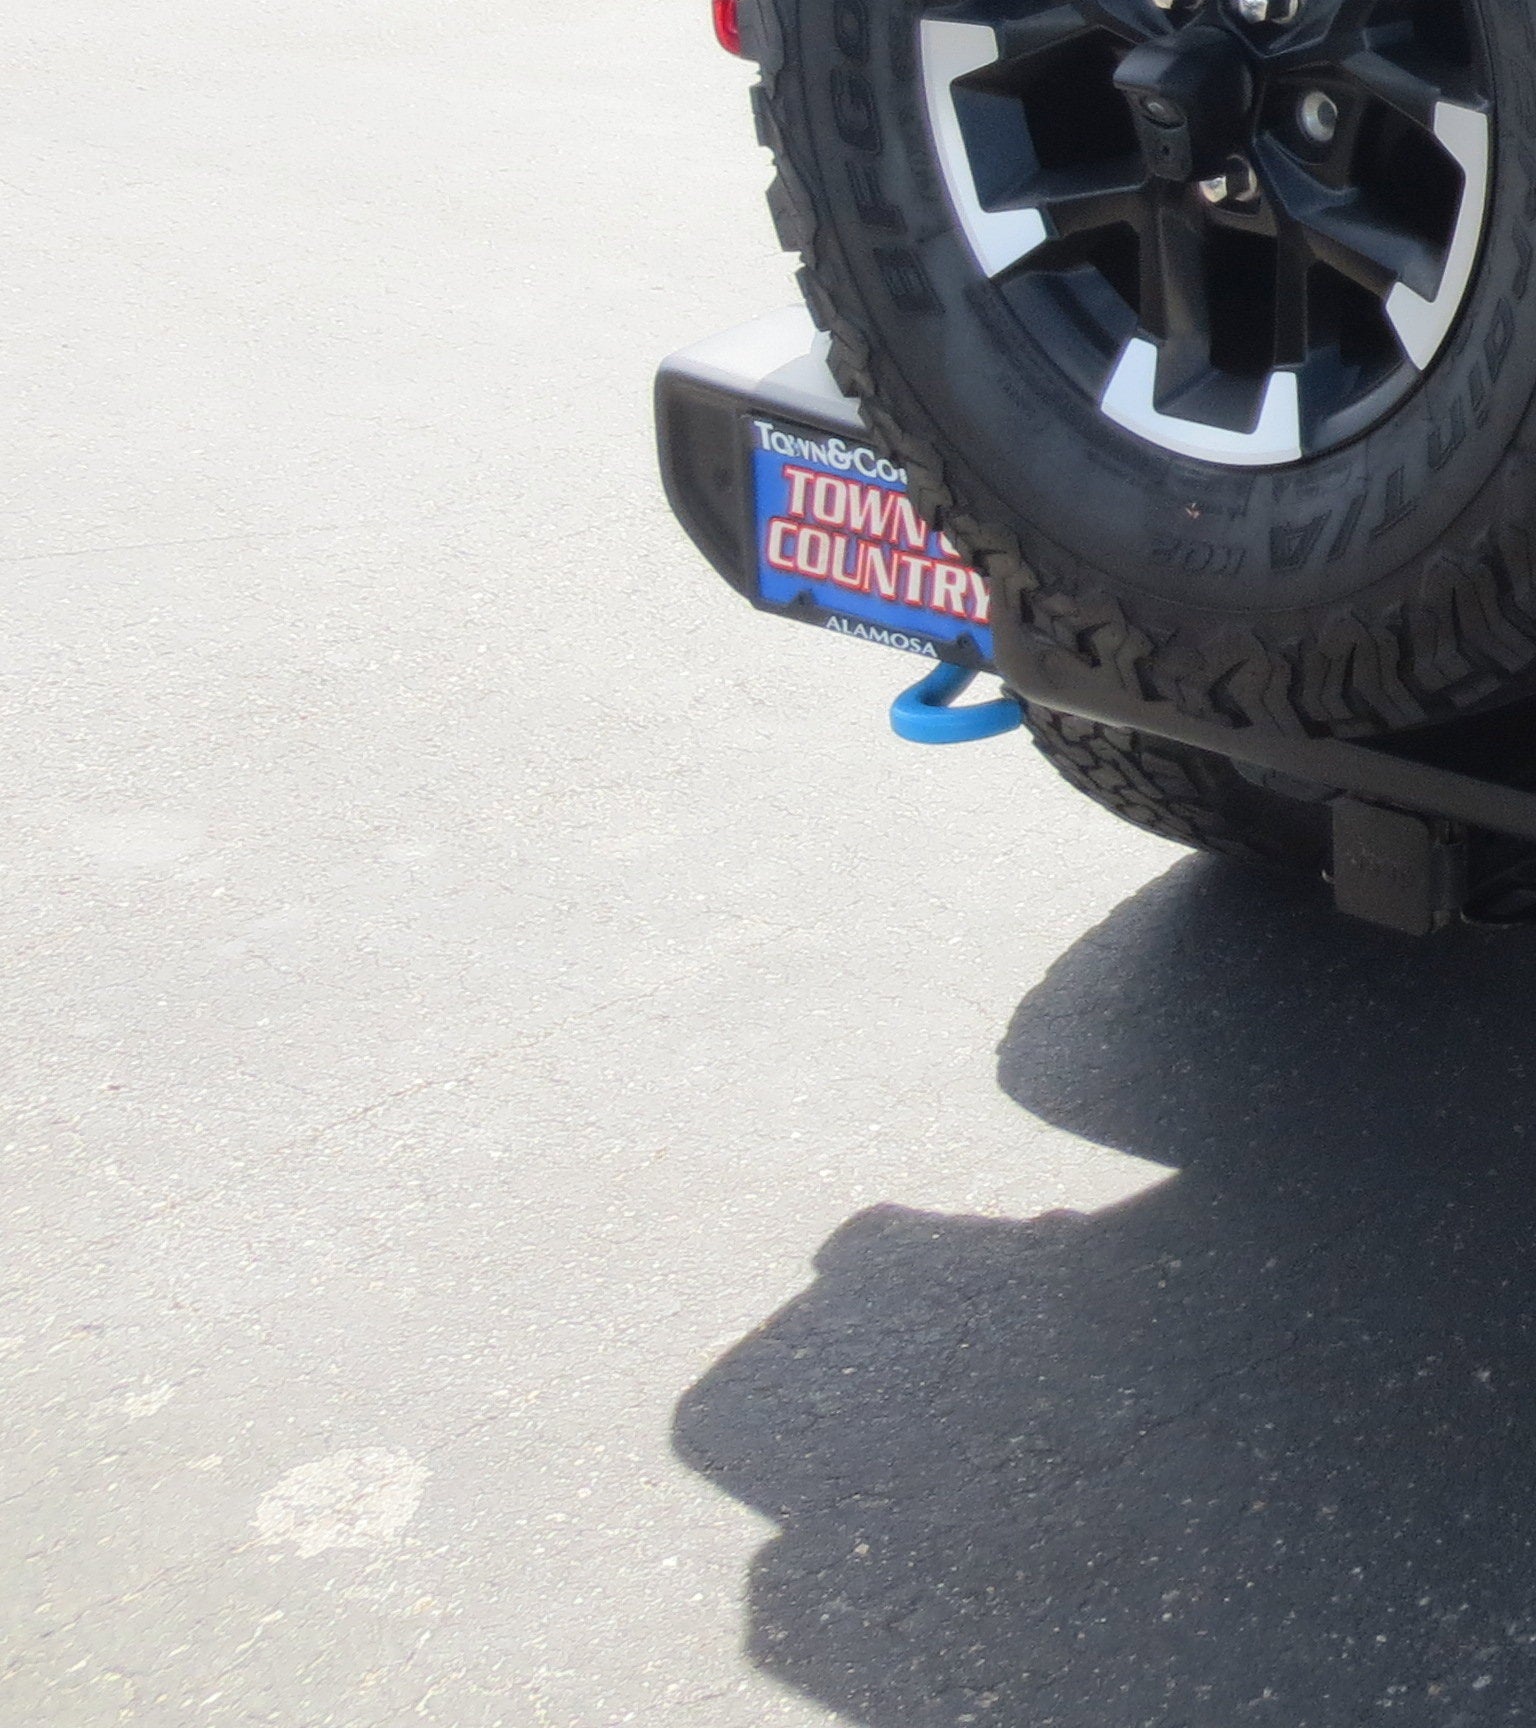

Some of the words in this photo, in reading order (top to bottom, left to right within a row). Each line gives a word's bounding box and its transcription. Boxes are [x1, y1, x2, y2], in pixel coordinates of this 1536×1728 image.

[783, 465, 927, 553] TOWN
[766, 517, 992, 624] COUNTRY
[824, 615, 940, 658] ALAMOSA
